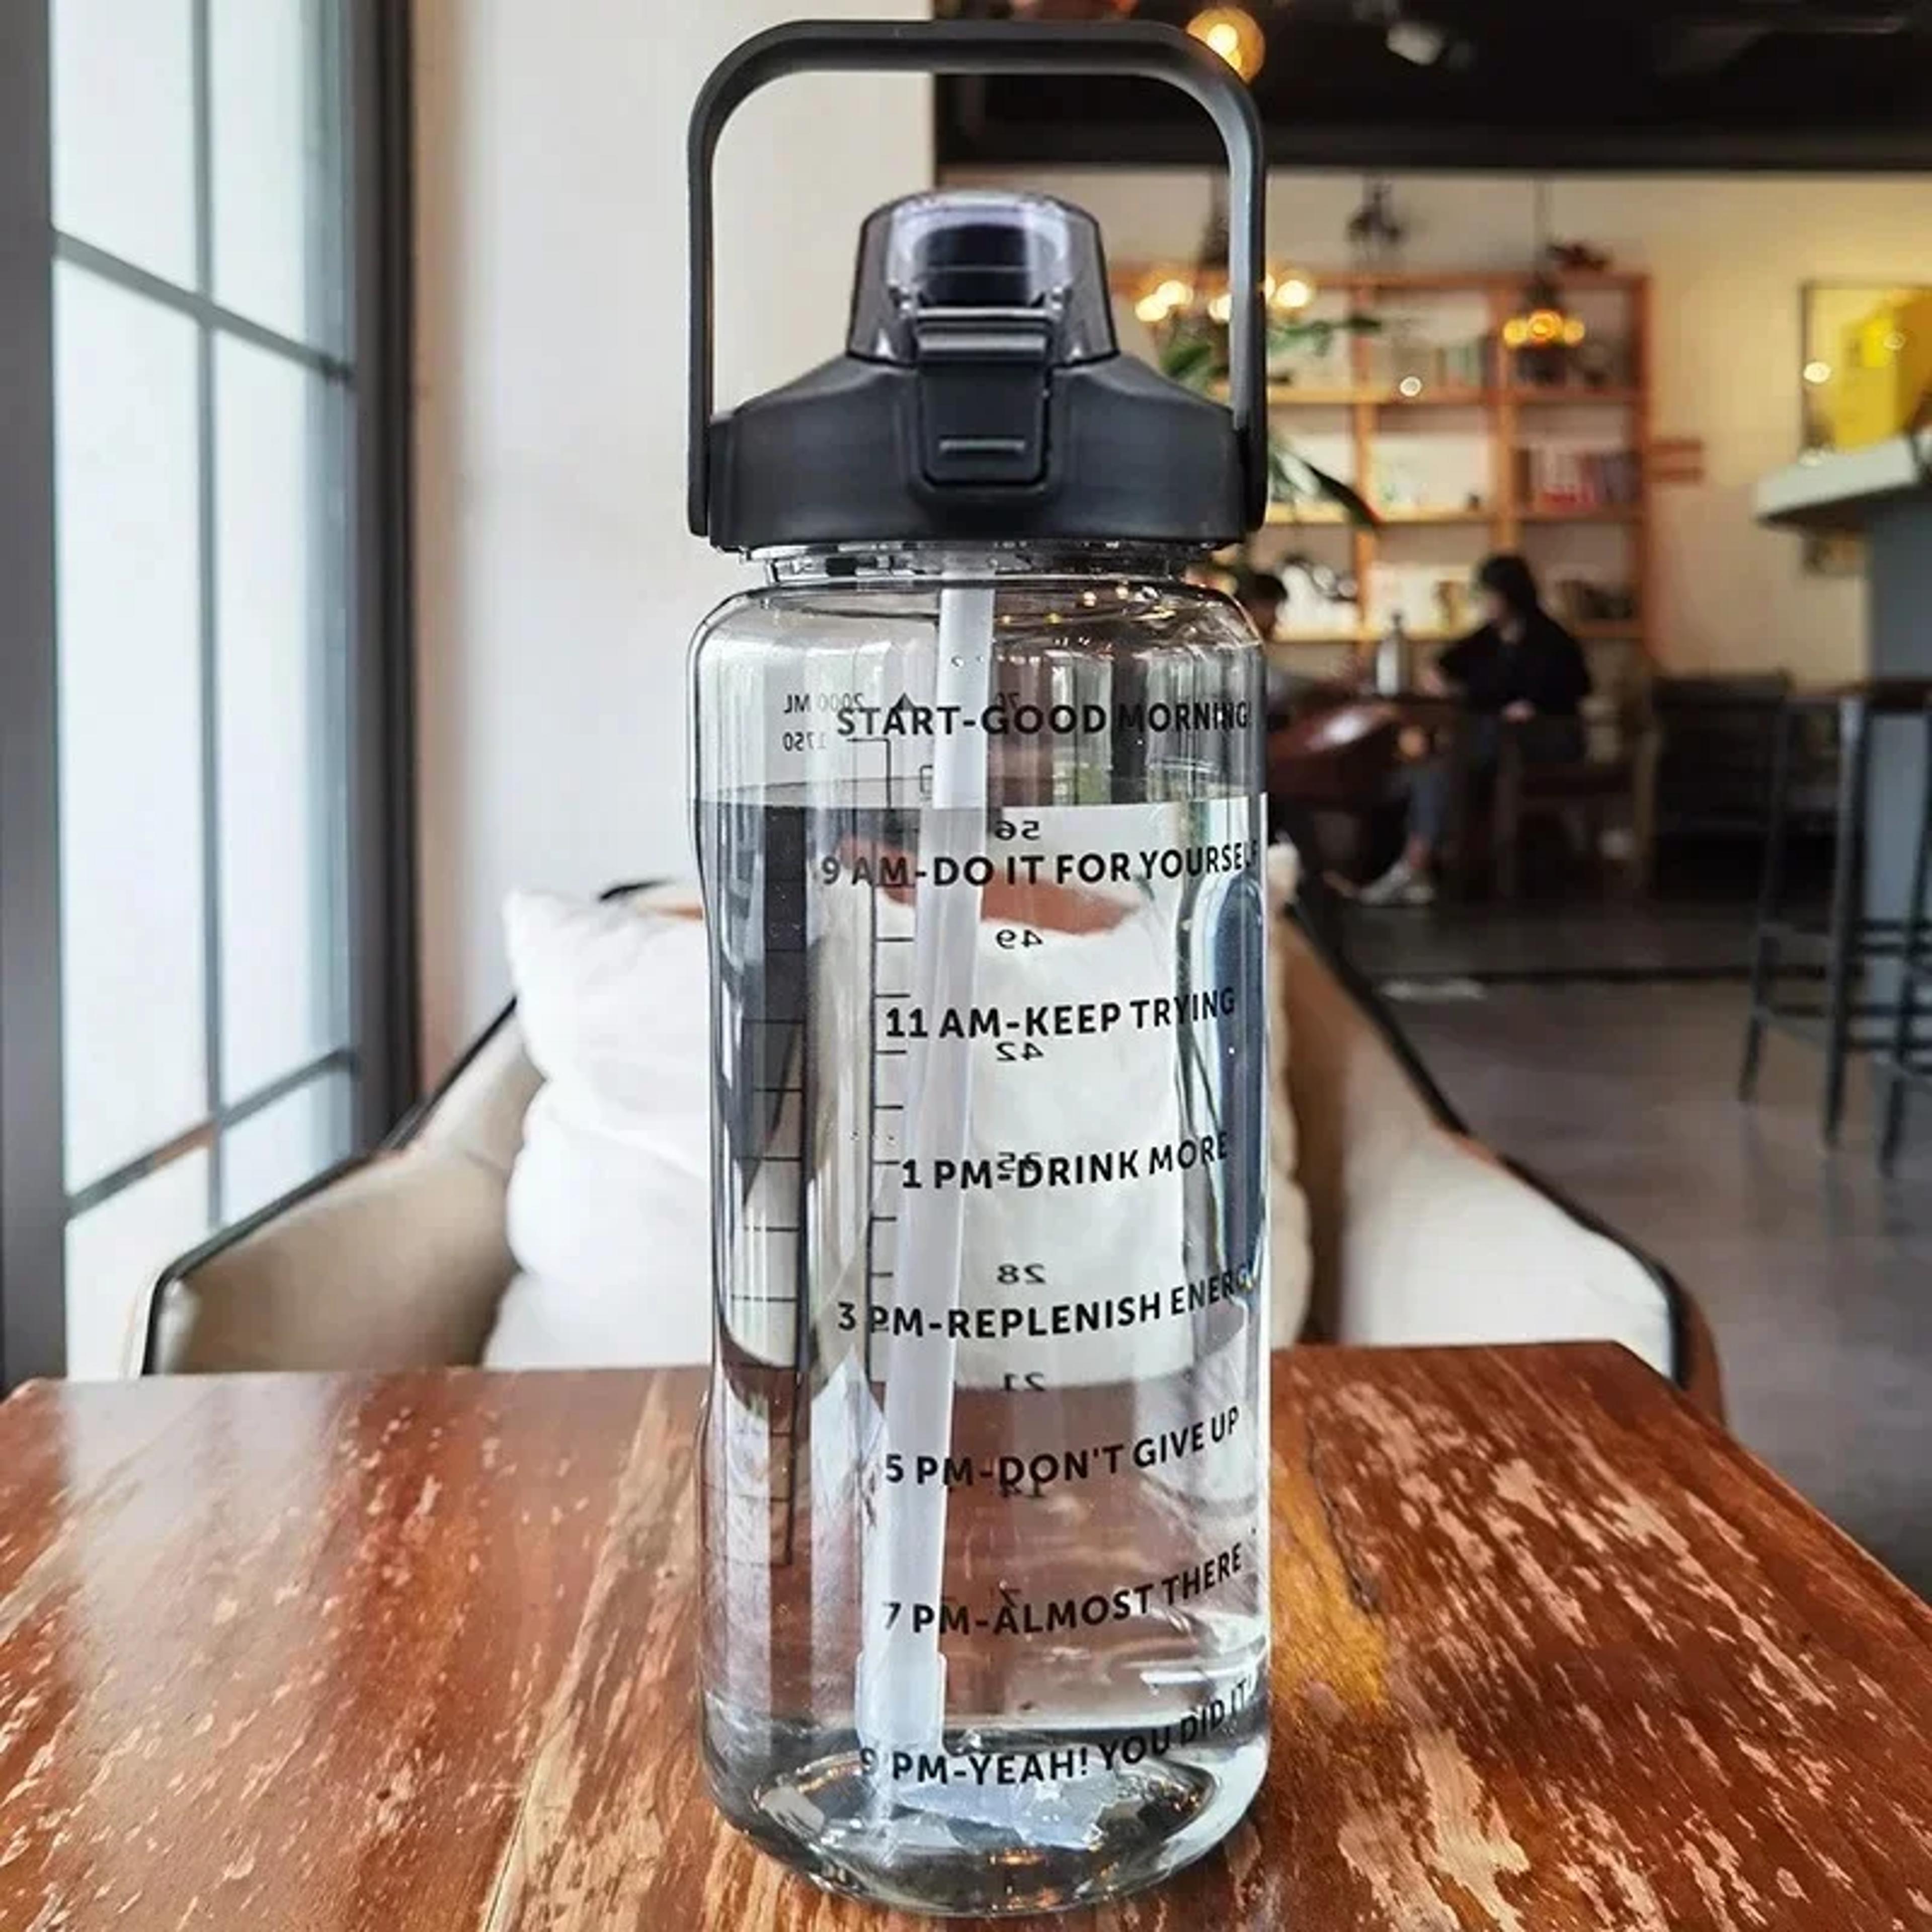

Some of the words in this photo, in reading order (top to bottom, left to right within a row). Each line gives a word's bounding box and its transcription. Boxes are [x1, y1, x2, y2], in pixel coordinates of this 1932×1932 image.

[837, 704, 1106, 736] START-GOOD
[821, 857, 840, 885] 9
[851, 856, 995, 886] AM-DO
[1007, 856, 1045, 885] IT
[1057, 853, 1131, 885] FOR
[886, 1007, 928, 1037] 11
[939, 1002, 1121, 1038] AM-KEEP
[1129, 987, 1235, 1029] TRYING
[903, 1159, 922, 1189] 1
[934, 1149, 1139, 1189] PM-DRINK
[1149, 1132, 1228, 1175] MORE
[838, 1301, 856, 1331] 3
[870, 1292, 1161, 1339] PM-REPLENISH
[886, 1454, 904, 1483] 5
[916, 1443, 1124, 1486] PM-DON'T
[1133, 1421, 1204, 1468] GIVE
[1211, 1405, 1240, 1443] UP
[882, 1602, 901, 1630] 7
[913, 1584, 1154, 1635] PM-ALMOST
[1161, 1543, 1242, 1606] THERE
[859, 1747, 877, 1776] 9
[892, 1747, 1088, 1785] PM-YEAH!
[1098, 1726, 1170, 1771] YOU
[1180, 1700, 1225, 1747] DID
